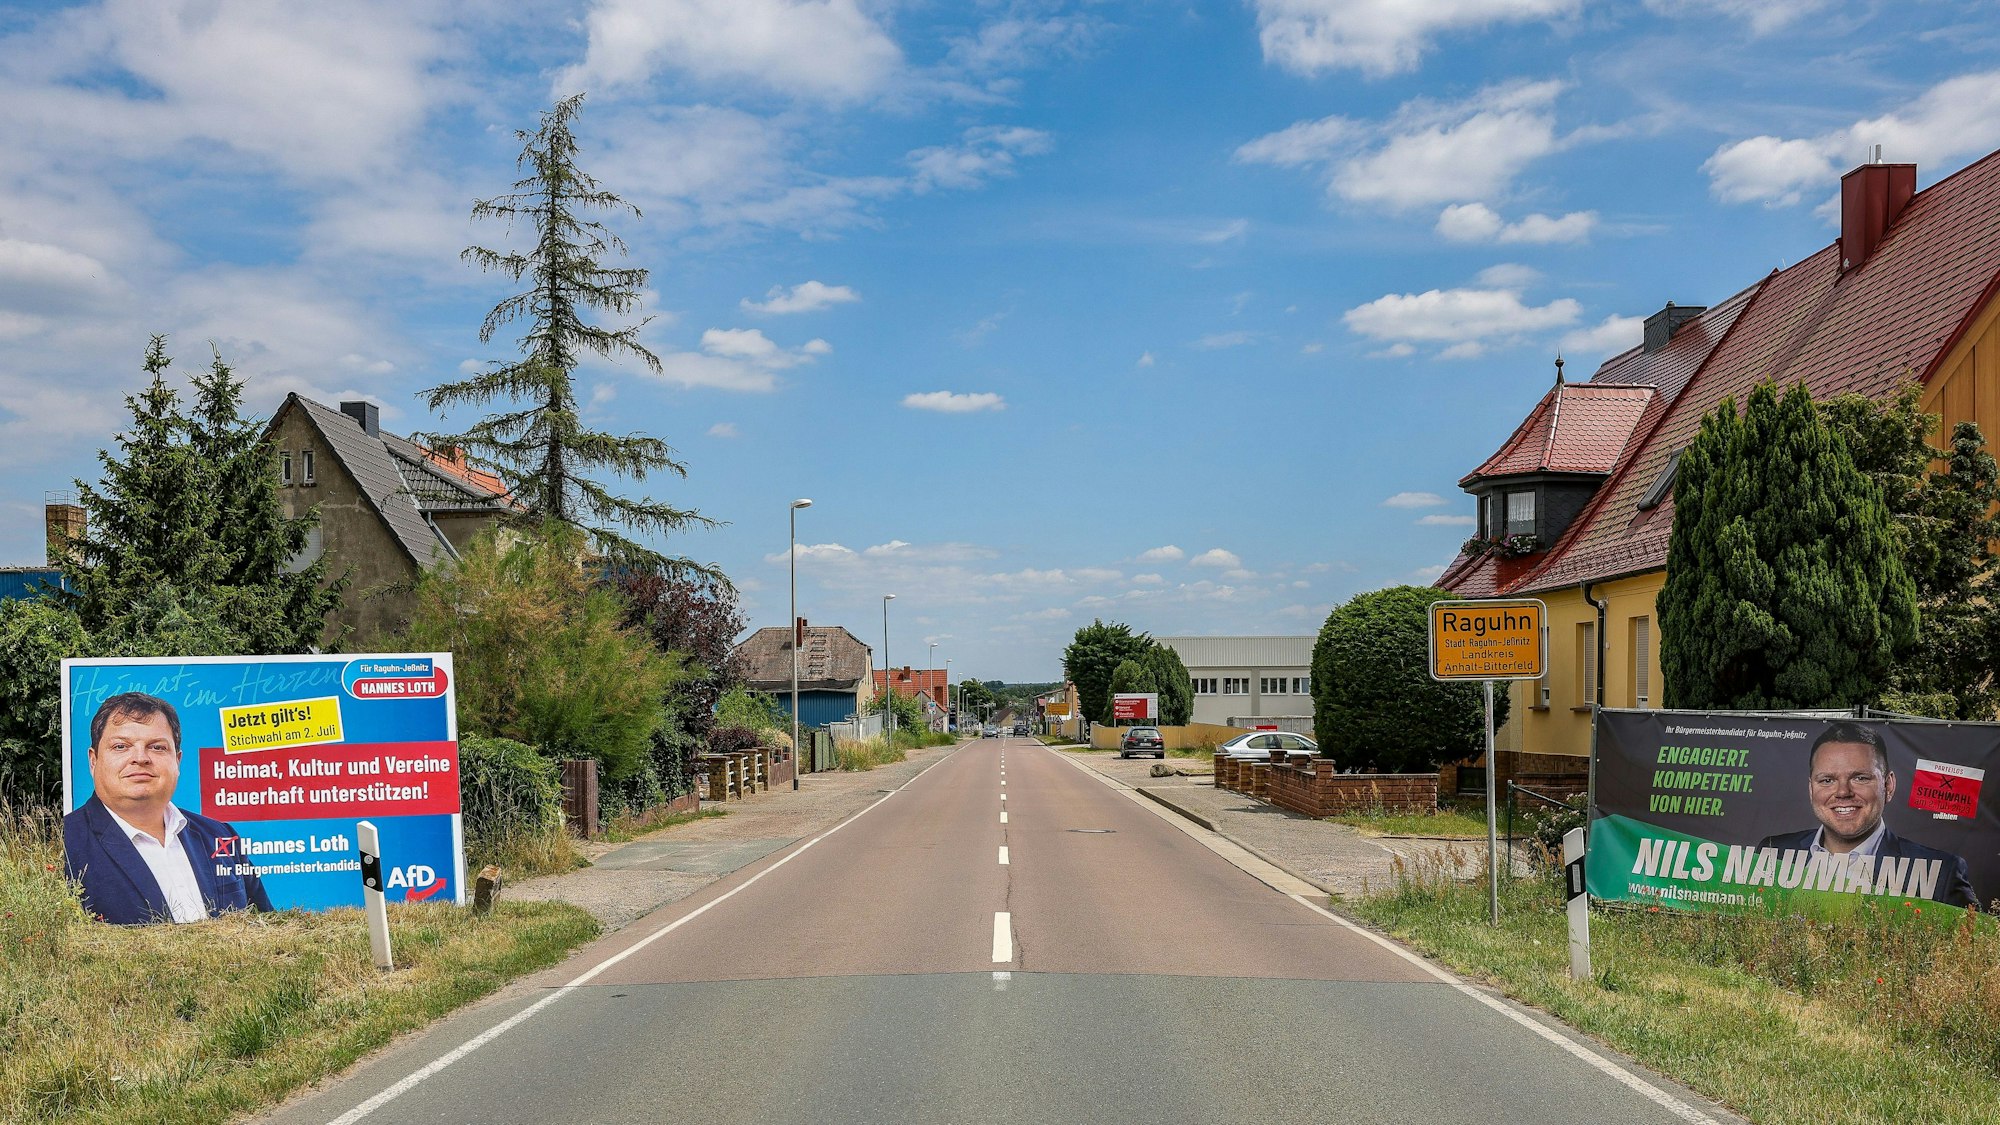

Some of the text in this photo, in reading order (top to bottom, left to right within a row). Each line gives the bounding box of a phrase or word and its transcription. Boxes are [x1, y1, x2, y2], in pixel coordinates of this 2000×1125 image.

[1443, 611, 1531, 636] Raguhn
[1445, 637, 1530, 649] Stadt Raguhn-Jeßnitz
[1462, 649, 1514, 659] Landkreis
[360, 663, 429, 674] Für Raguhn-Jeßnitz
[1444, 661, 1533, 673] Anhalt-Bitterfeld
[71, 664, 341, 716] Heimat im Herzen
[361, 681, 436, 695] HANNES LOTH
[228, 711, 266, 729] Jetzt
[230, 725, 336, 747] Stichwahl am 2. Juli
[1665, 725, 1807, 739] Ihr Bürgermeisterkandidat für Raguhn-Jeßnitz
[1657, 746, 1749, 768] ENGAGIERT.
[214, 754, 450, 780] Heimat, Kultur und Vereine
[1934, 764, 1964, 775] PARTEILOS
[1652, 770, 1753, 793] KOMPETENT.
[215, 781, 428, 806] dauerhaft unterstützen!
[1914, 799, 1926, 807] am
[1916, 787, 1972, 805] STICHWAHL
[1649, 794, 1725, 817] VON HIER.
[1933, 811, 1959, 821] wählen
[241, 834, 349, 855] Hannes Loth
[216, 860, 362, 878] Ihr Bürgermeisterkandida
[387, 865, 436, 888] AfD
[1632, 838, 1943, 900] NILS NAUMANN
[1628, 882, 1763, 907] wwwnilsnaumann.de
